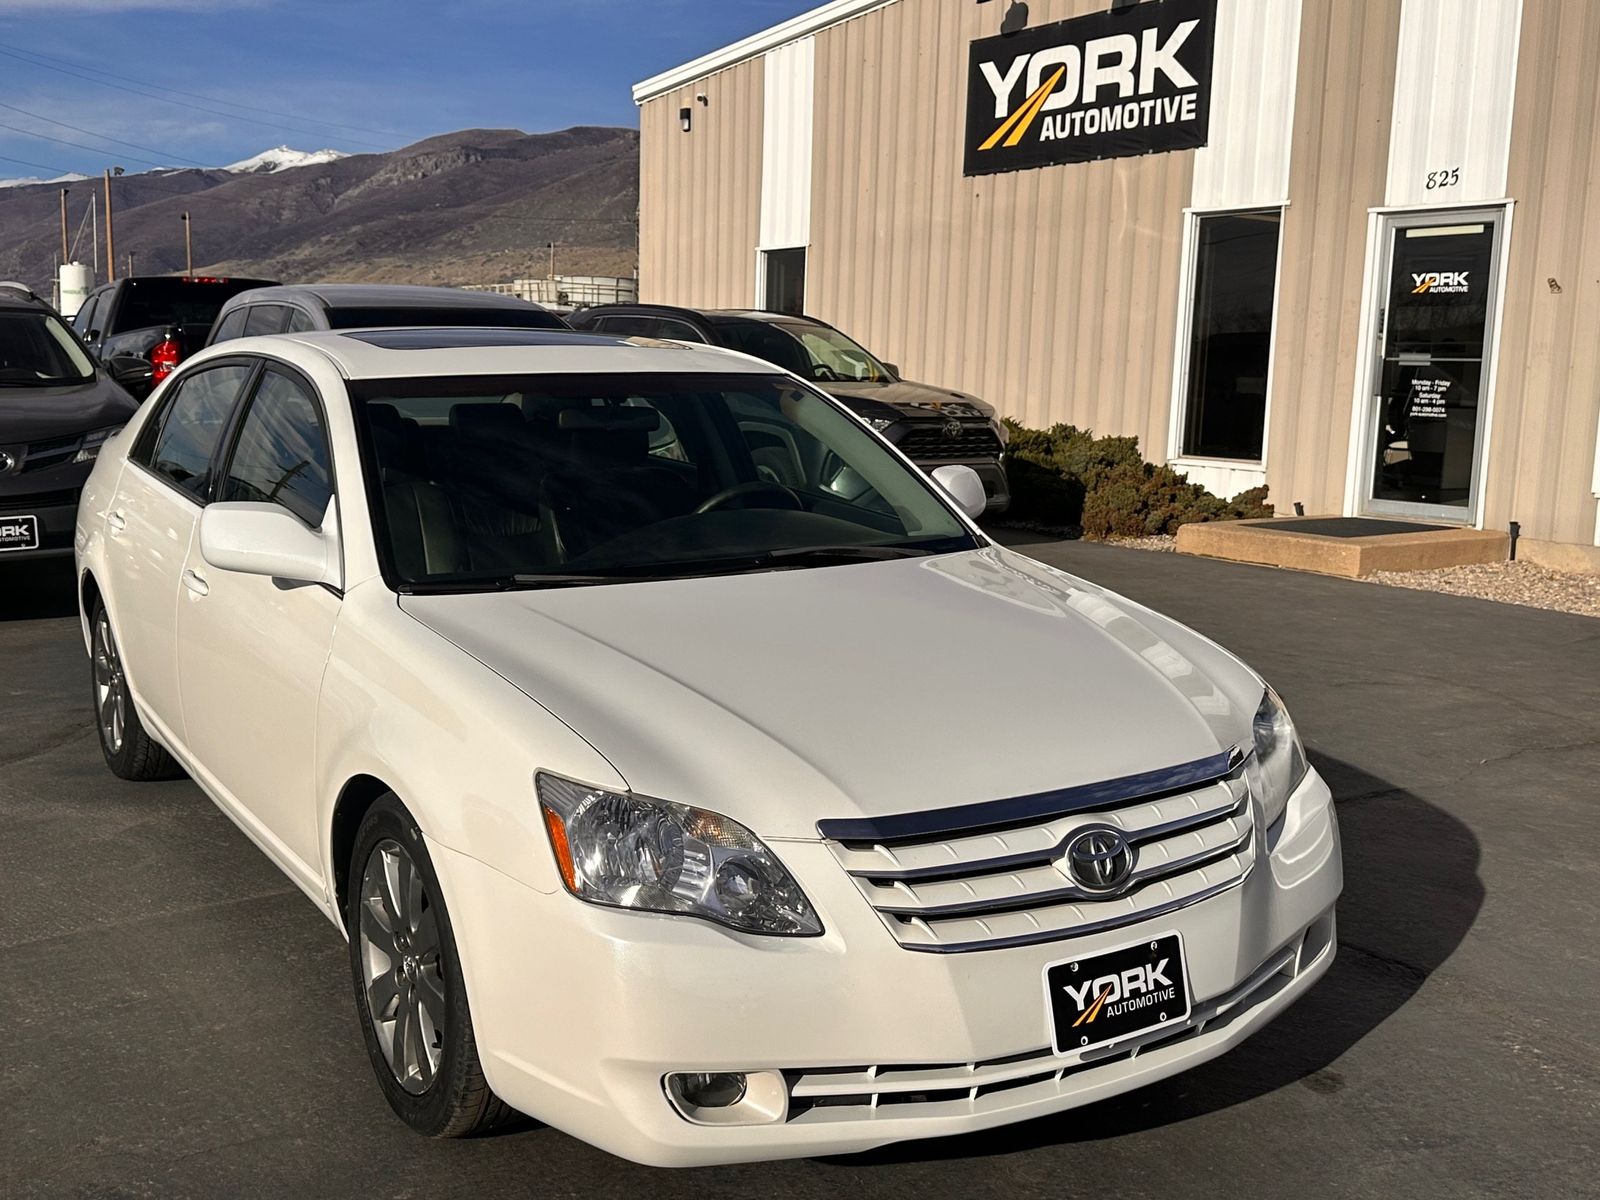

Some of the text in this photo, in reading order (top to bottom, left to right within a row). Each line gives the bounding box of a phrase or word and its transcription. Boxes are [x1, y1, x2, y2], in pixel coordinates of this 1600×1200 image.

[979, 19, 1200, 118] YORK
[1039, 92, 1197, 142] AUTOMOTIVE
[1426, 167, 1460, 190] 825
[1411, 271, 1469, 287] YORK
[1429, 285, 1469, 293] AUTOMOTIVE
[0, 525, 30, 537] RK
[1063, 957, 1173, 1011] YORK
[1106, 986, 1176, 1018] AUTOMOTIVE
